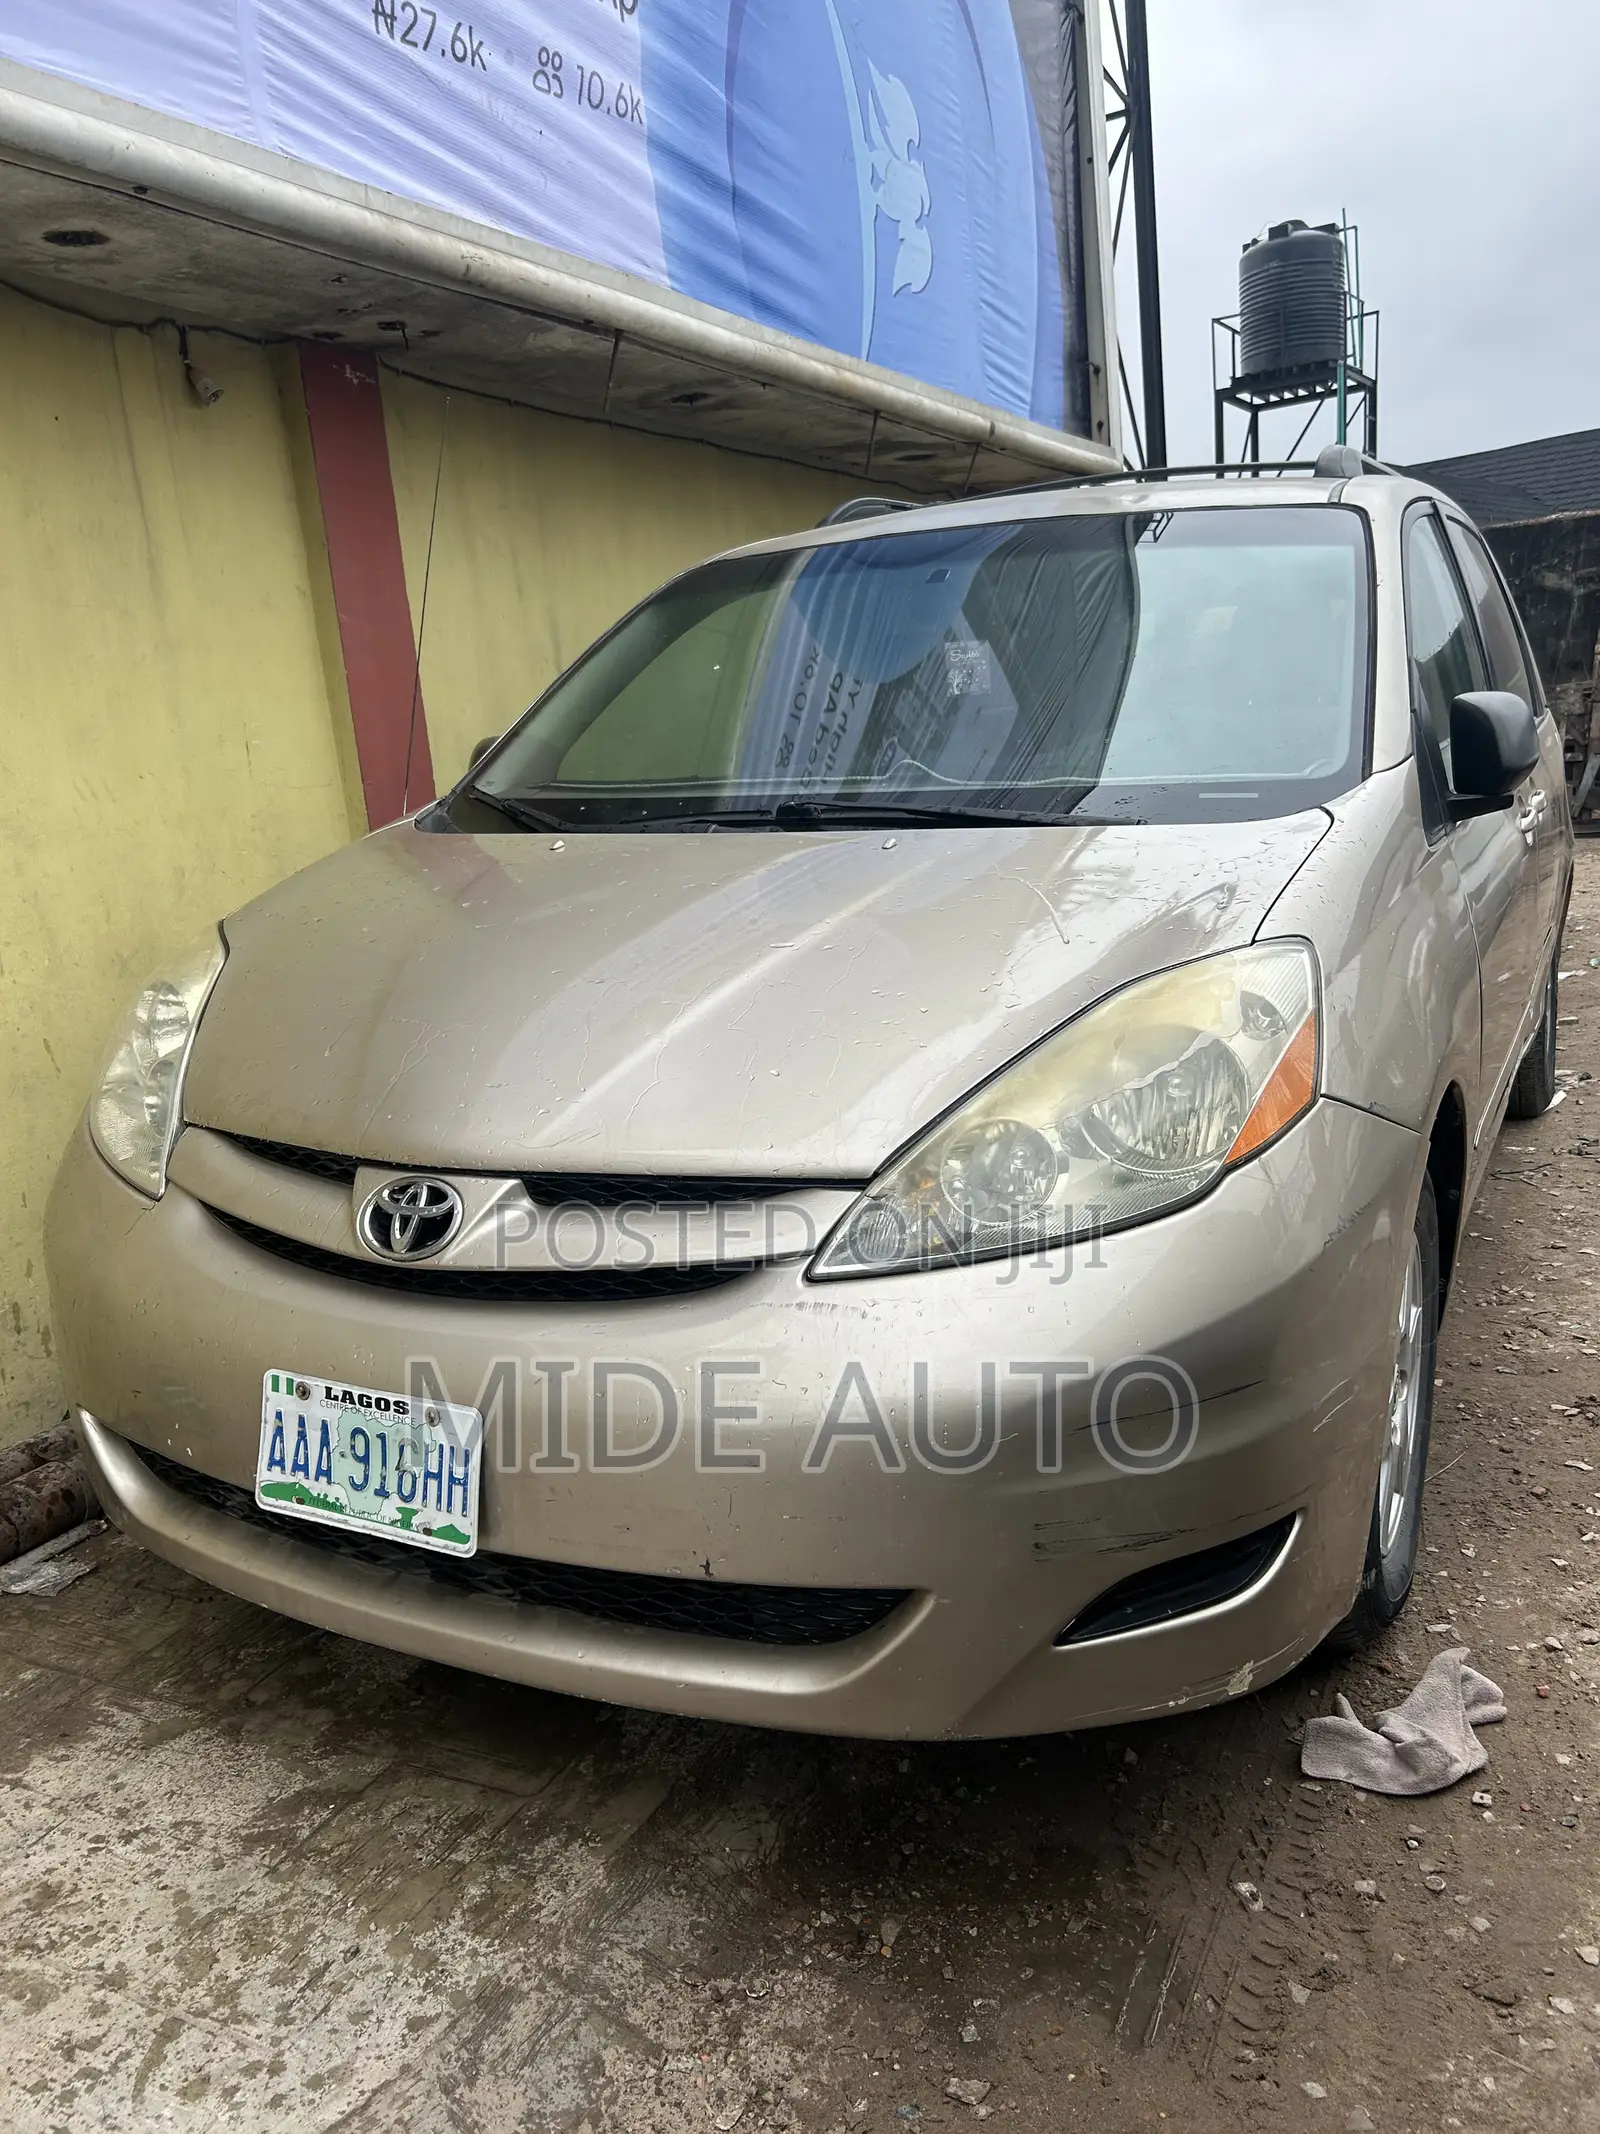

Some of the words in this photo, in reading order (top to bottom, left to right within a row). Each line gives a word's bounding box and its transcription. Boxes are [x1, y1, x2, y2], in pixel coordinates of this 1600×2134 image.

[576, 65, 644, 125] 10.6k
[320, 1400, 349, 1413] CENTRE
[351, 1406, 362, 1415] OF
[364, 1409, 416, 1426] EXCELLENCE
[324, 1386, 410, 1416] LAGOS
